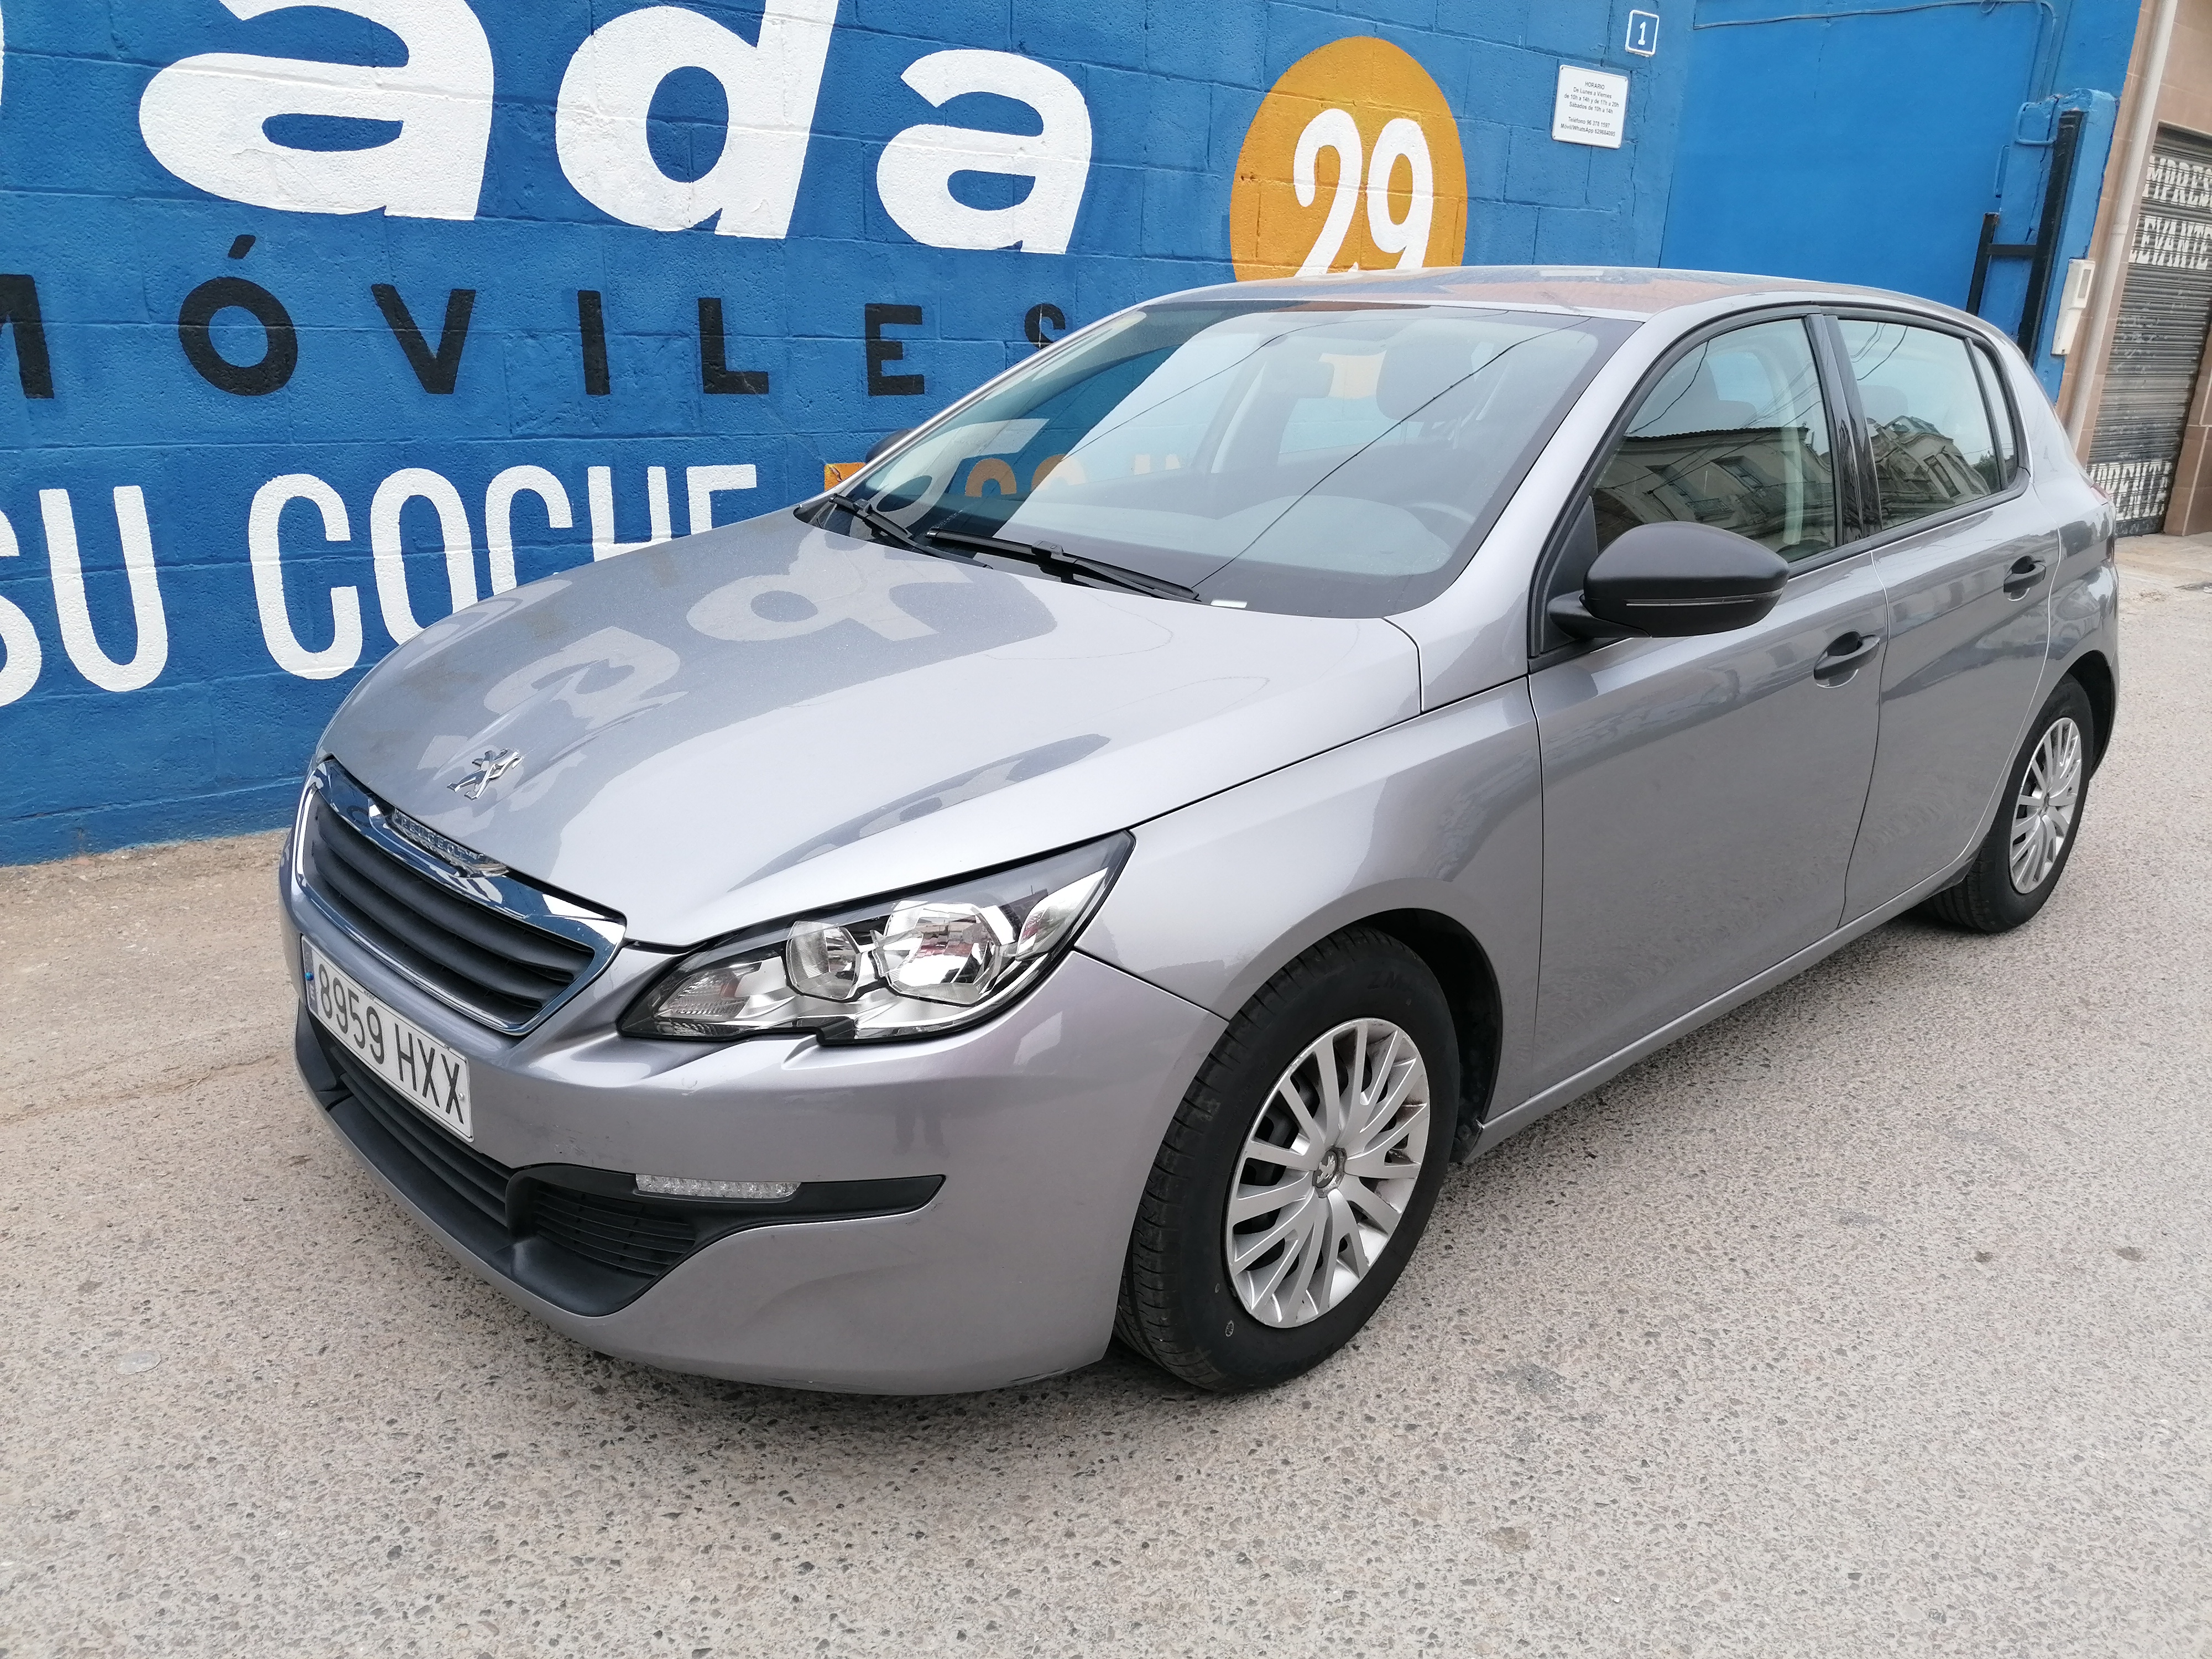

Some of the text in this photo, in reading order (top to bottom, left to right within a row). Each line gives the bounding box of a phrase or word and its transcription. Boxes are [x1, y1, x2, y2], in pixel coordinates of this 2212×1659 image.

[1585, 81, 1605, 90] HORARIO
[1637, 21, 1646, 45] 1
[0, 0, 1093, 254] ada
[1293, 108, 1433, 278] 29
[319, 963, 464, 1125] 8959 HXX
